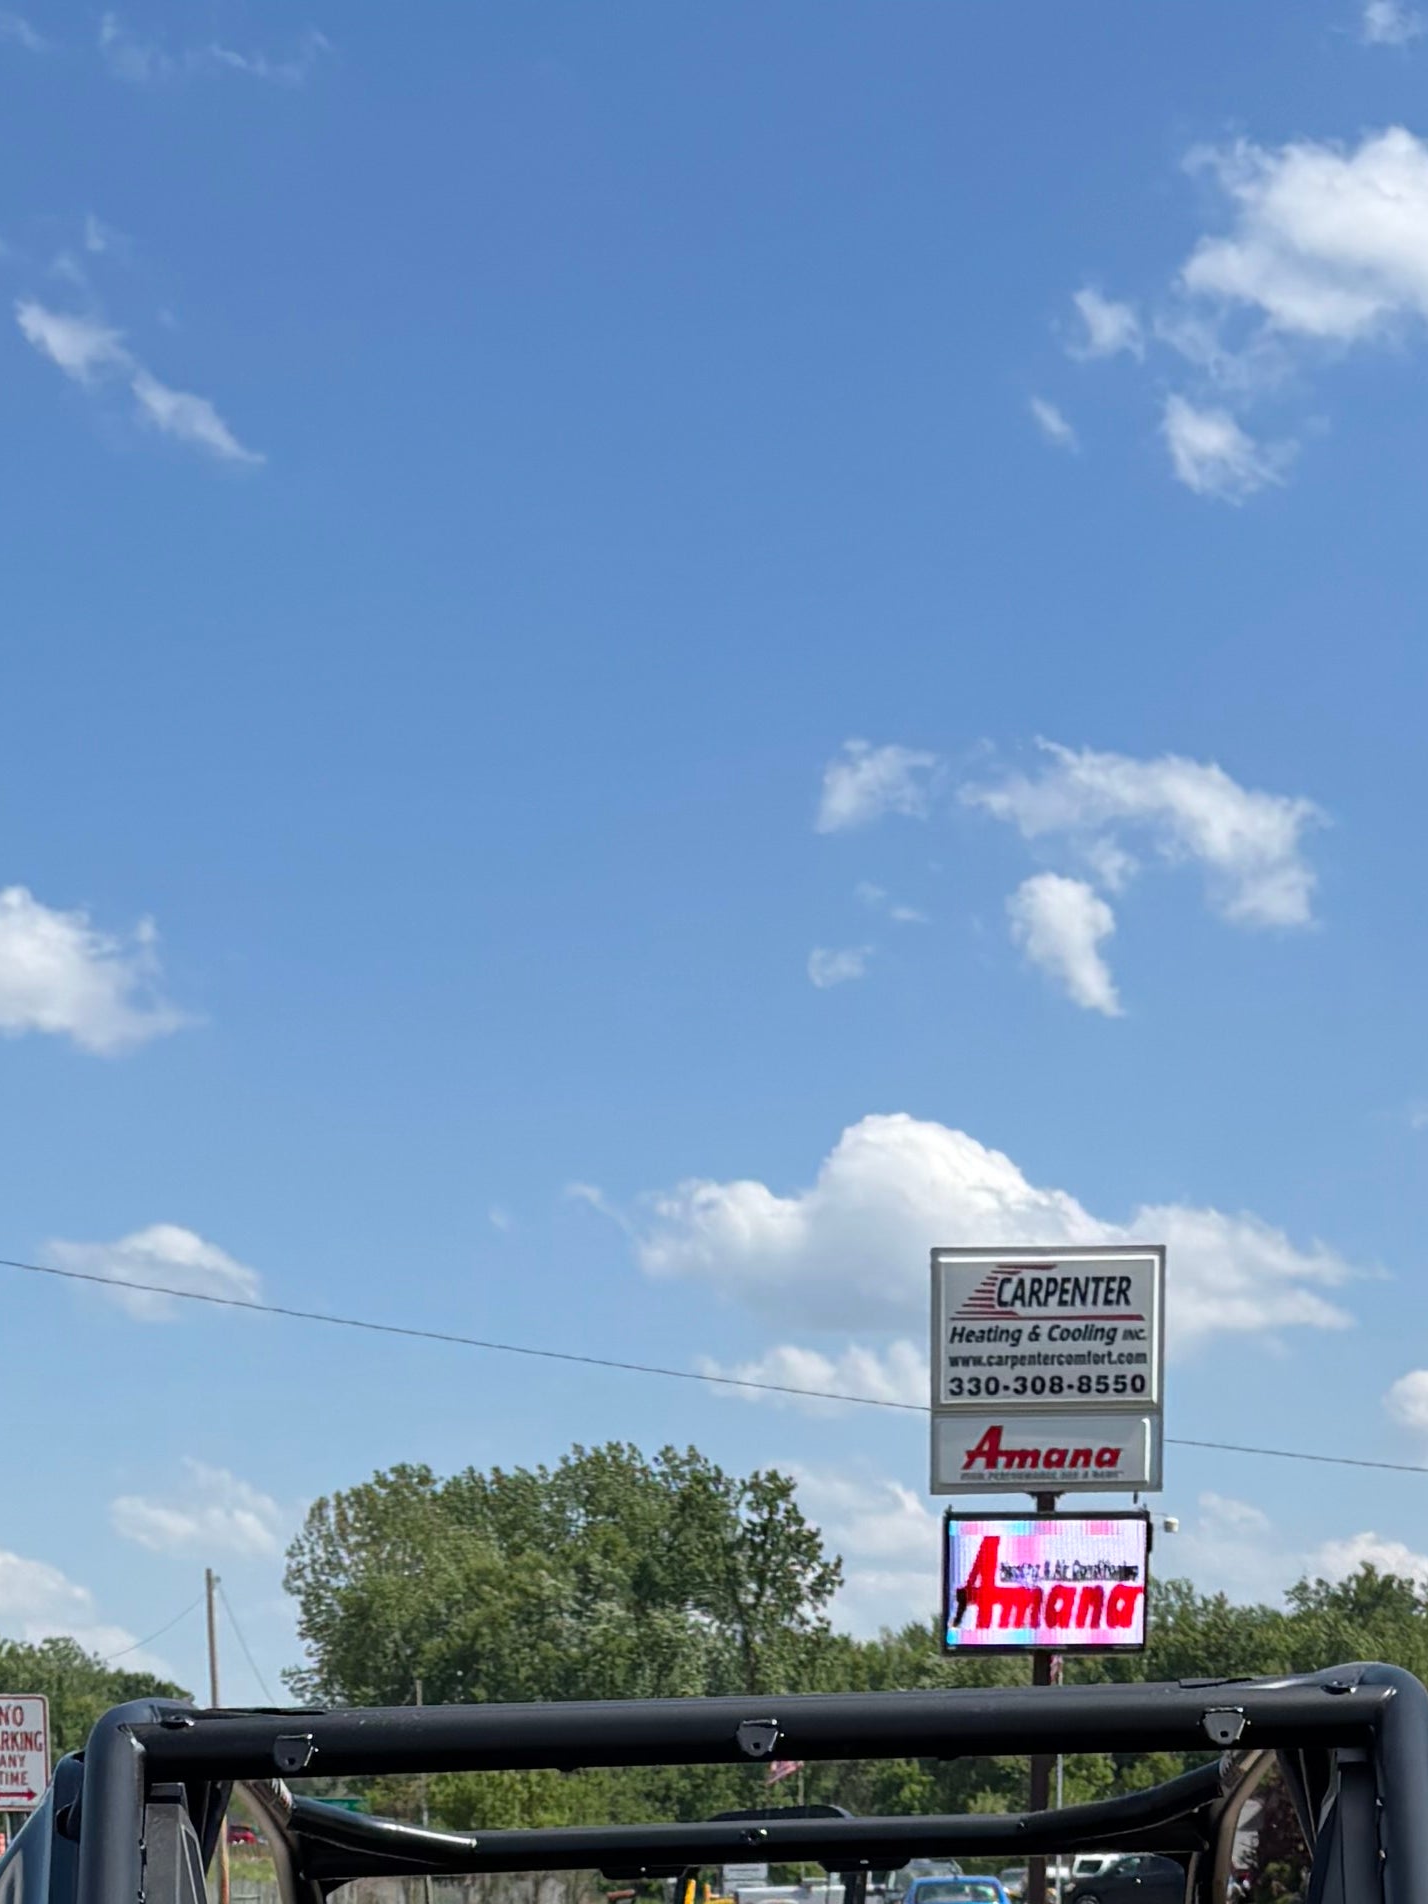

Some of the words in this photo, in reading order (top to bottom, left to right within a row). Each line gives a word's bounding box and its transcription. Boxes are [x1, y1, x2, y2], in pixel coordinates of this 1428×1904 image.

[996, 1276, 1133, 1309] CARPENTER
[948, 1325, 1023, 1347] Heating
[1027, 1324, 1041, 1342] &
[1047, 1324, 1118, 1345] Cooling
[948, 1351, 1147, 1370] www.carpentercomfort.com
[961, 1424, 1124, 1471] Amana
[953, 1535, 1144, 1629] Amana
